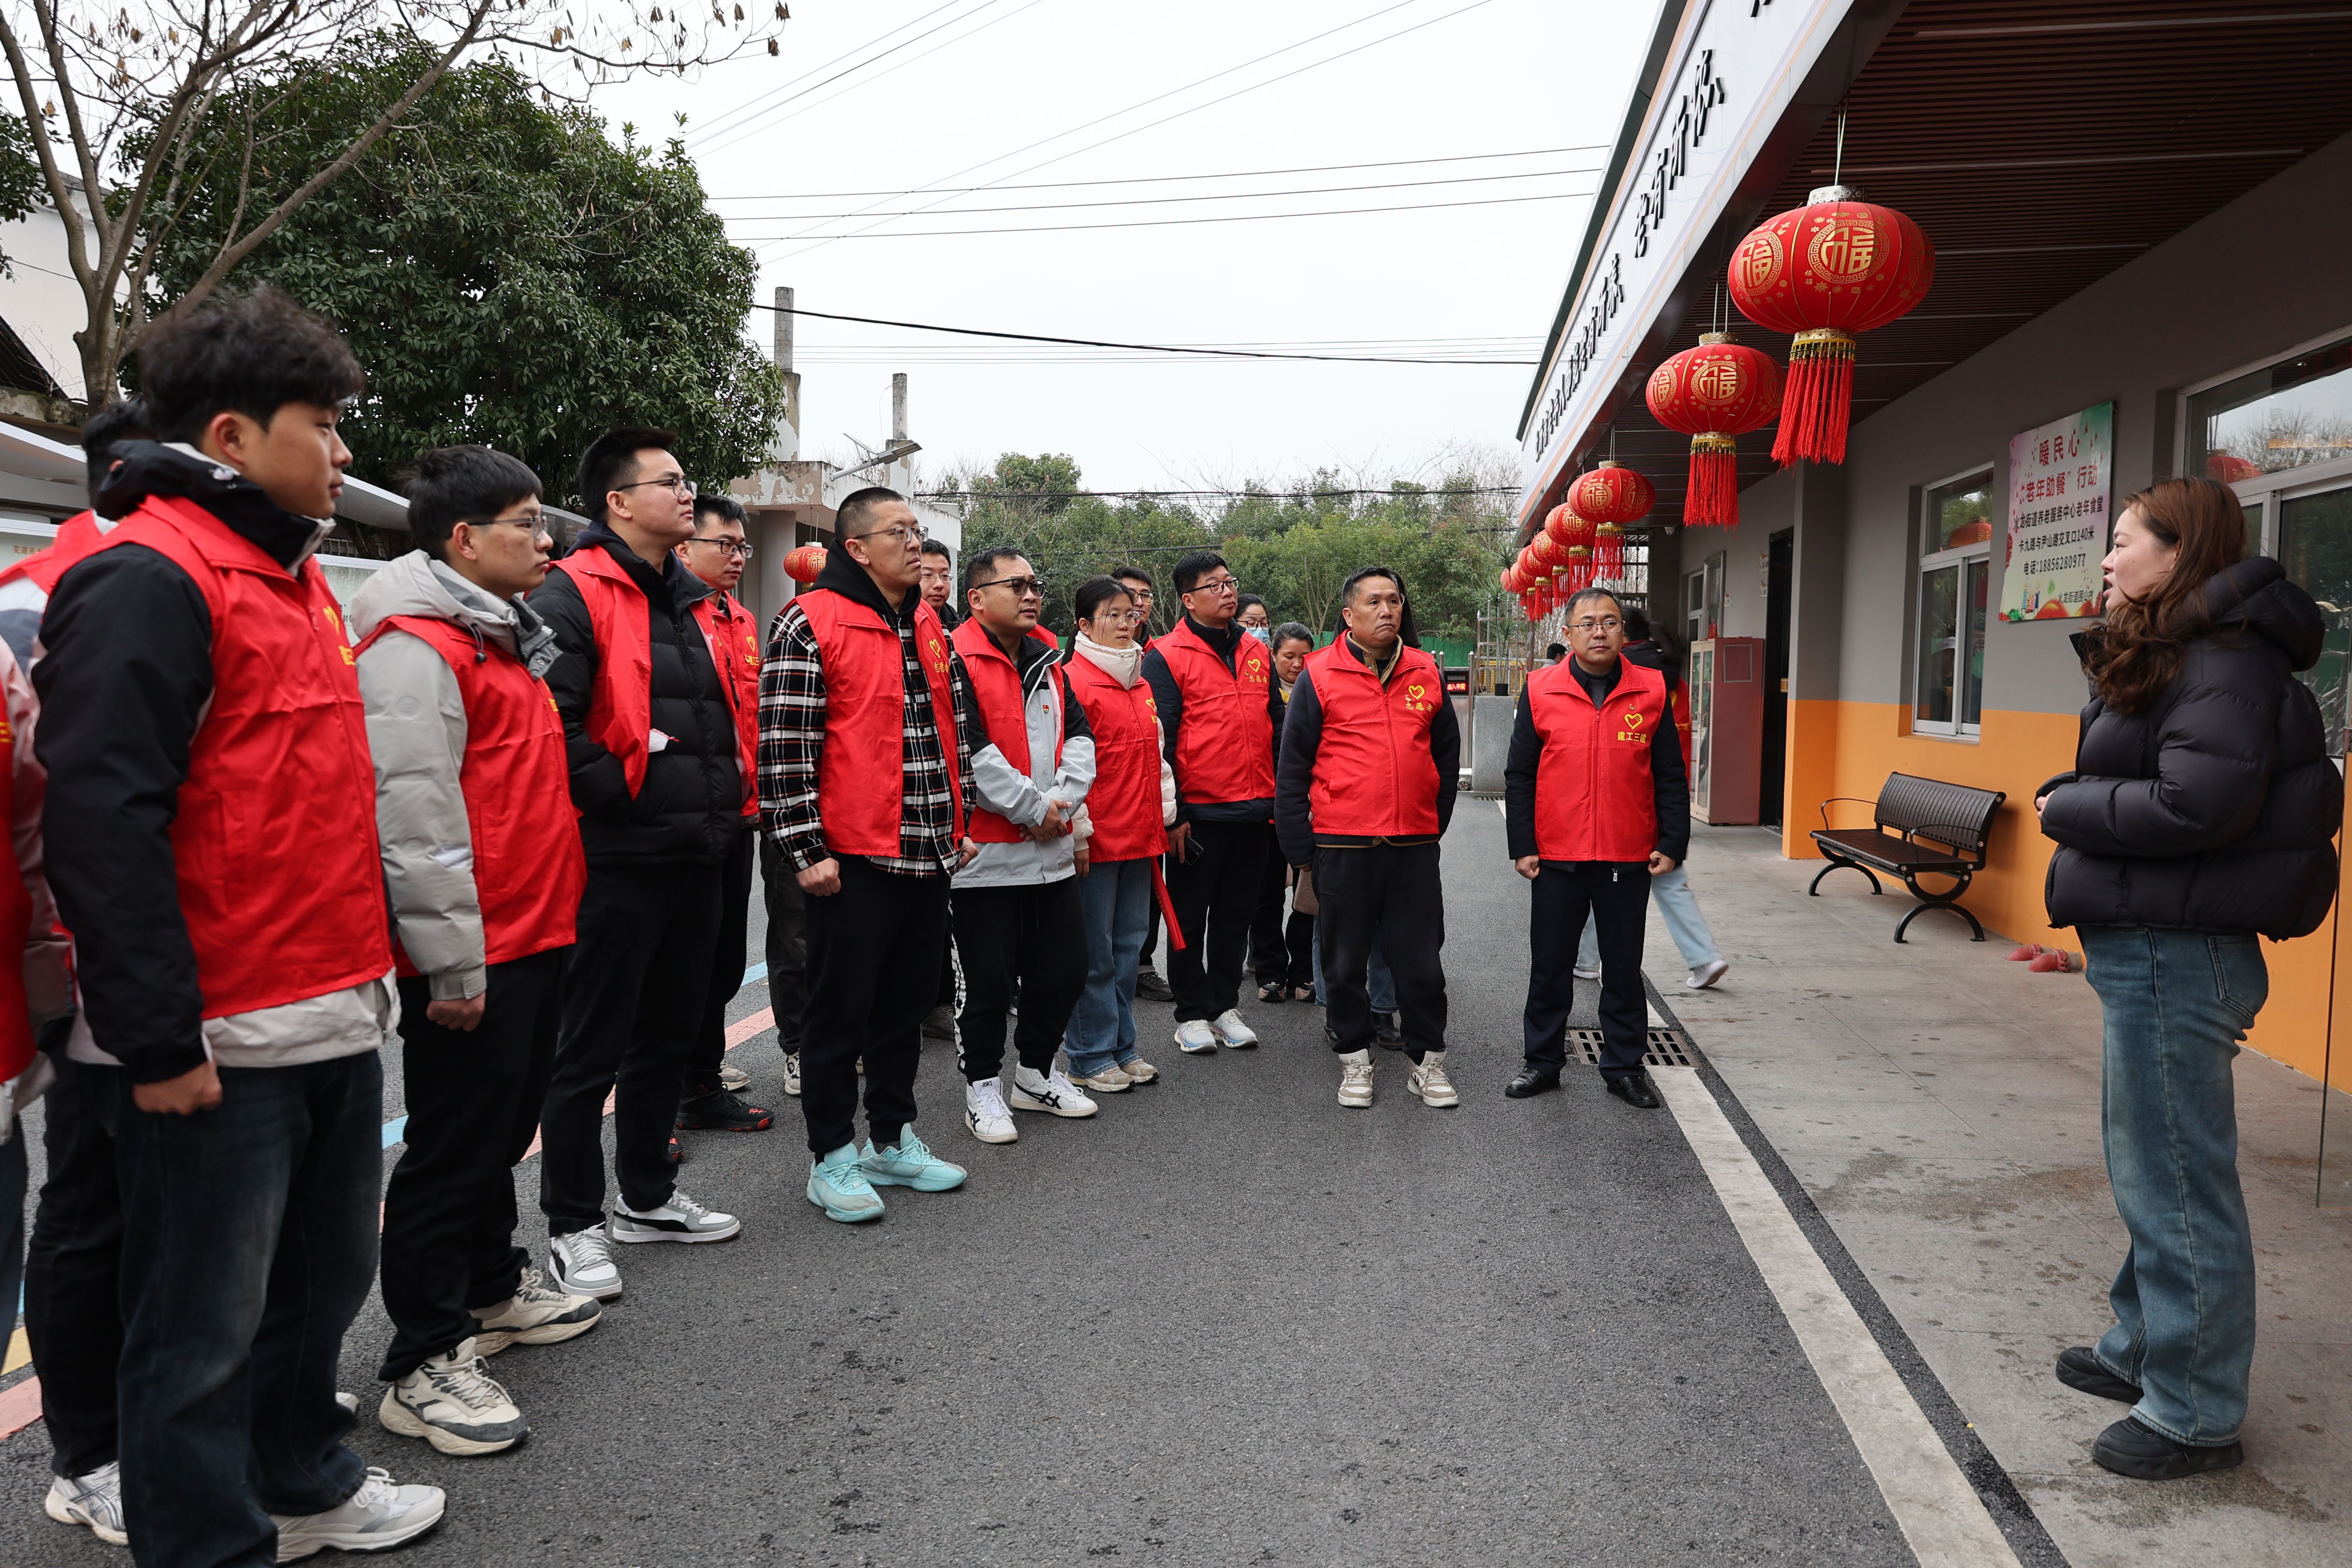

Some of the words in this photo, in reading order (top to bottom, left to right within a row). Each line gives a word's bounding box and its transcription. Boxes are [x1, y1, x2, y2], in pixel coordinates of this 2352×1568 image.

[1821, 227, 1879, 273] 福
[1700, 366, 1738, 399] 福
[2040, 429, 2079, 466] 暖民心
[2077, 465, 2098, 490] 行动
[1585, 487, 1608, 507] 福
[1628, 485, 1647, 505] 福
[2013, 496, 2104, 530] 火龙街道养老服务中心老年食堂
[1536, 537, 1548, 551] 福
[811, 557, 826, 571] 福
[934, 662, 949, 673] 志愿者
[1249, 674, 1267, 683] 志愿者
[1406, 702, 1433, 712] 志愿者
[1617, 731, 1647, 743] 建工三建
